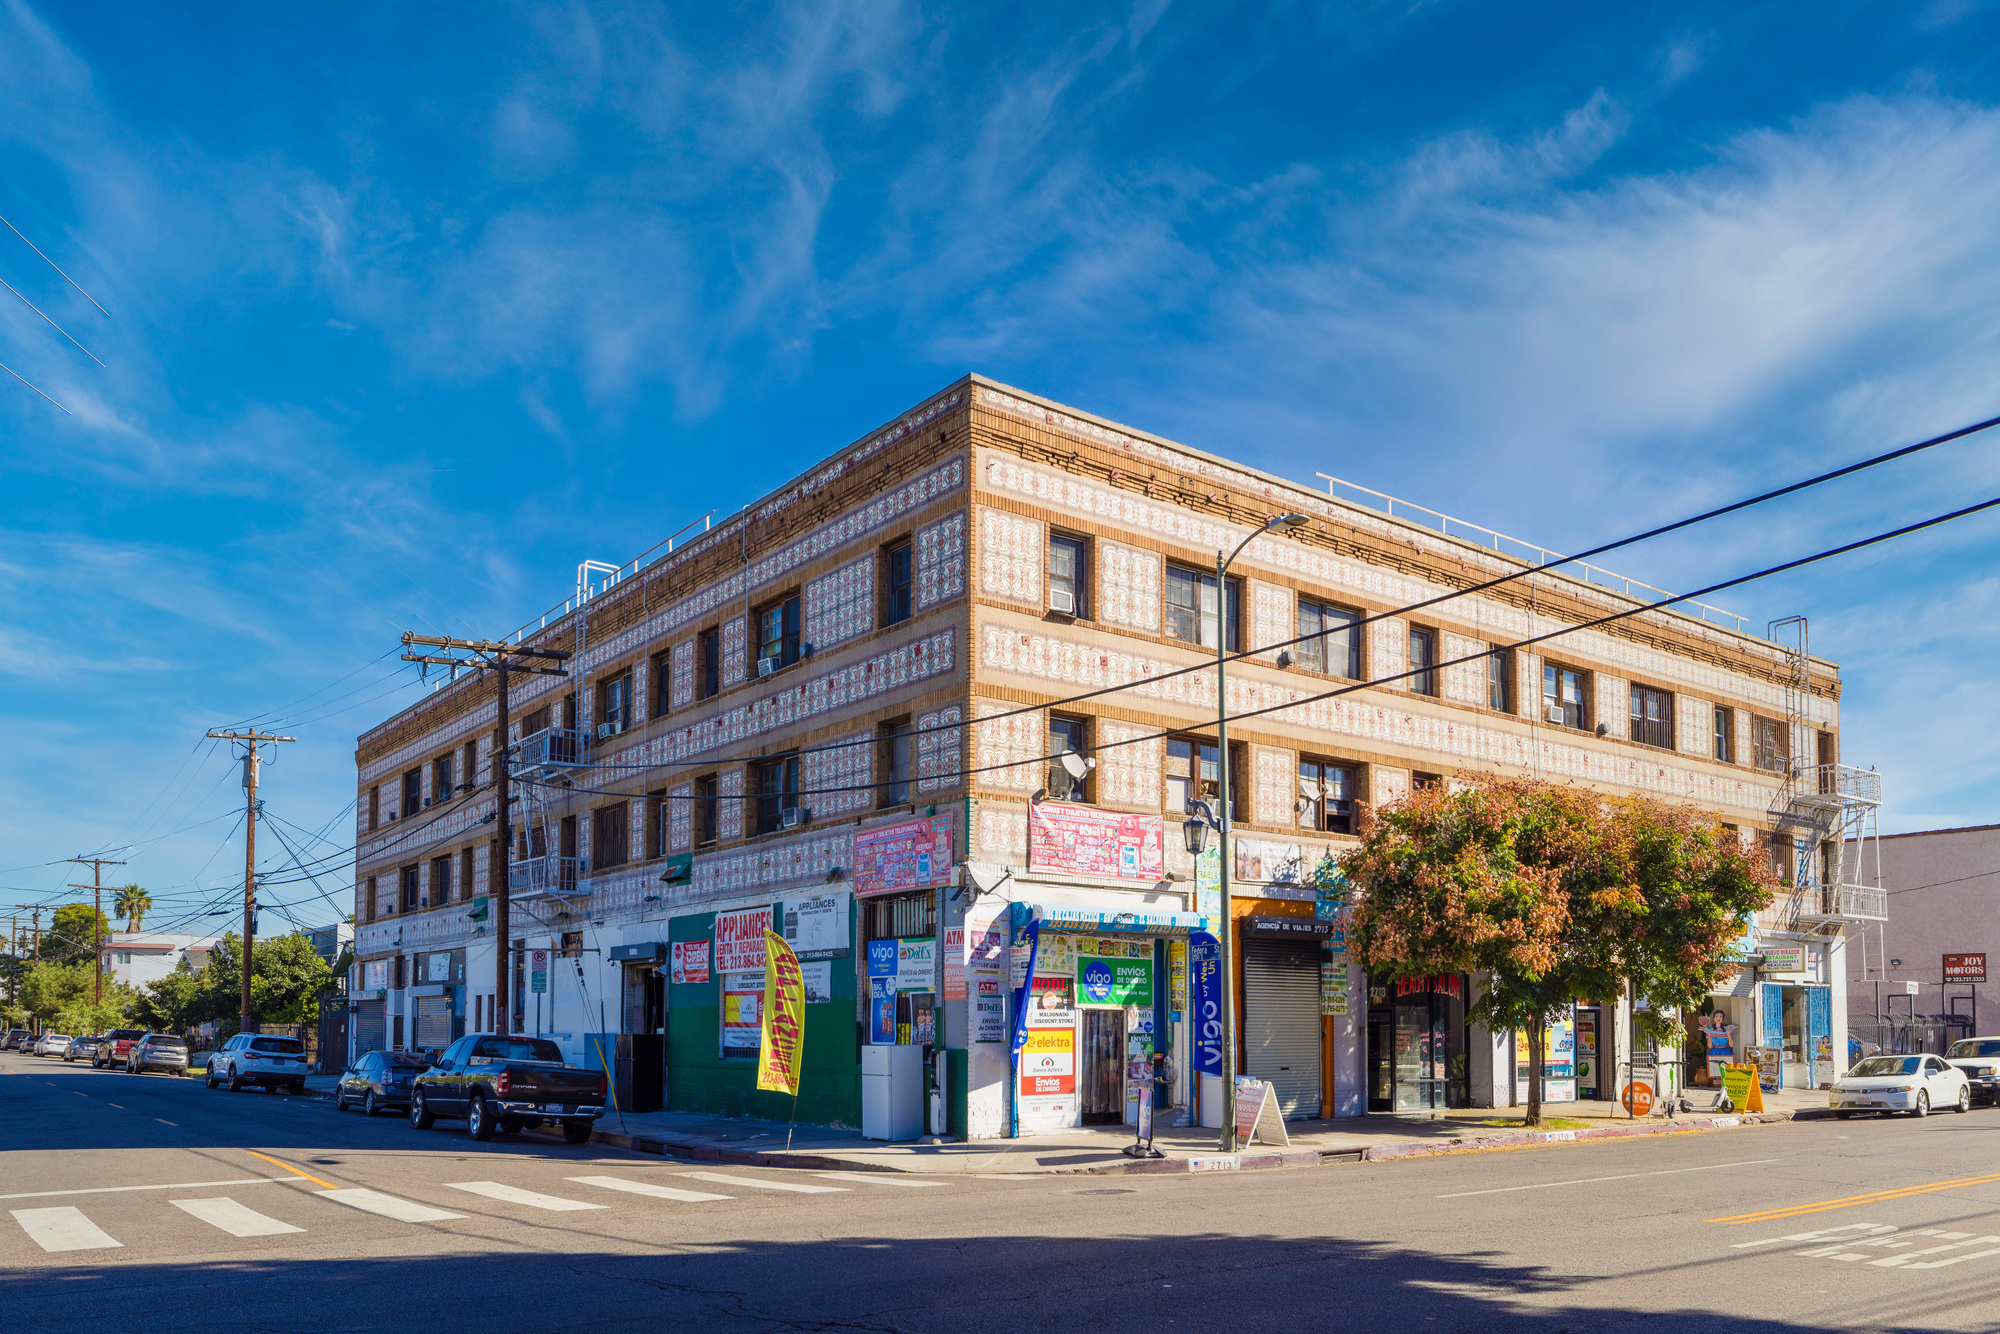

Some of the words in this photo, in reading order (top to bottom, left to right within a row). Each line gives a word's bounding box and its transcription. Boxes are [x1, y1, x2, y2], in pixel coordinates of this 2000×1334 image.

[930, 816, 952, 825] ENVIO
[1064, 808, 1090, 818] TARJETAS
[1089, 812, 1122, 822] TELEFONICAS
[856, 833, 874, 842] RECARGAS
[877, 828, 895, 838] TARJETAS
[894, 823, 919, 835] TELEFONICAS
[916, 842, 933, 851] SERVICIO
[798, 899, 836, 911] APPLIANCES
[1061, 909, 1079, 921] CAJAS
[716, 911, 772, 943] APPLIANCES
[1257, 922, 1281, 931] AGENCIA
[1282, 923, 1290, 931] DE
[1292, 924, 1312, 932] VIAJES
[1313, 925, 1328, 934] 2713
[945, 930, 965, 945] ATM
[716, 943, 734, 955] VENTA
[734, 942, 739, 954] Y
[739, 940, 766, 954] REPARACI
[871, 944, 893, 962] vigo
[906, 946, 931, 960] DolEx
[1191, 946, 1208, 955] Fedora
[1213, 944, 1221, 953] St
[716, 955, 729, 970] TEL:
[730, 953, 767, 969] 213.864.942
[1962, 957, 1984, 966] JOY
[918, 968, 934, 976] DINERO
[1117, 966, 1146, 976] ENVÍOS
[1945, 966, 1985, 974] MOTORS
[1086, 970, 1111, 986] vigo
[1126, 977, 1148, 985] DINERO
[873, 983, 883, 991] BIG
[1032, 977, 1068, 992] RODU
[1397, 973, 1431, 998] BEAUTY
[1433, 973, 1461, 1001] SALON
[873, 991, 887, 999] DEAL
[1370, 986, 1386, 998] 2713
[984, 1002, 1004, 1011] DolEx
[769, 953, 800, 1074] APPLIANCES
[981, 1017, 1000, 1025] ENVÍOS
[1200, 1000, 1222, 1066] vigo
[1036, 1036, 1070, 1048] elektra
[1036, 1076, 1061, 1086] Envíos
[1211, 1161, 1233, 1170] 2713
